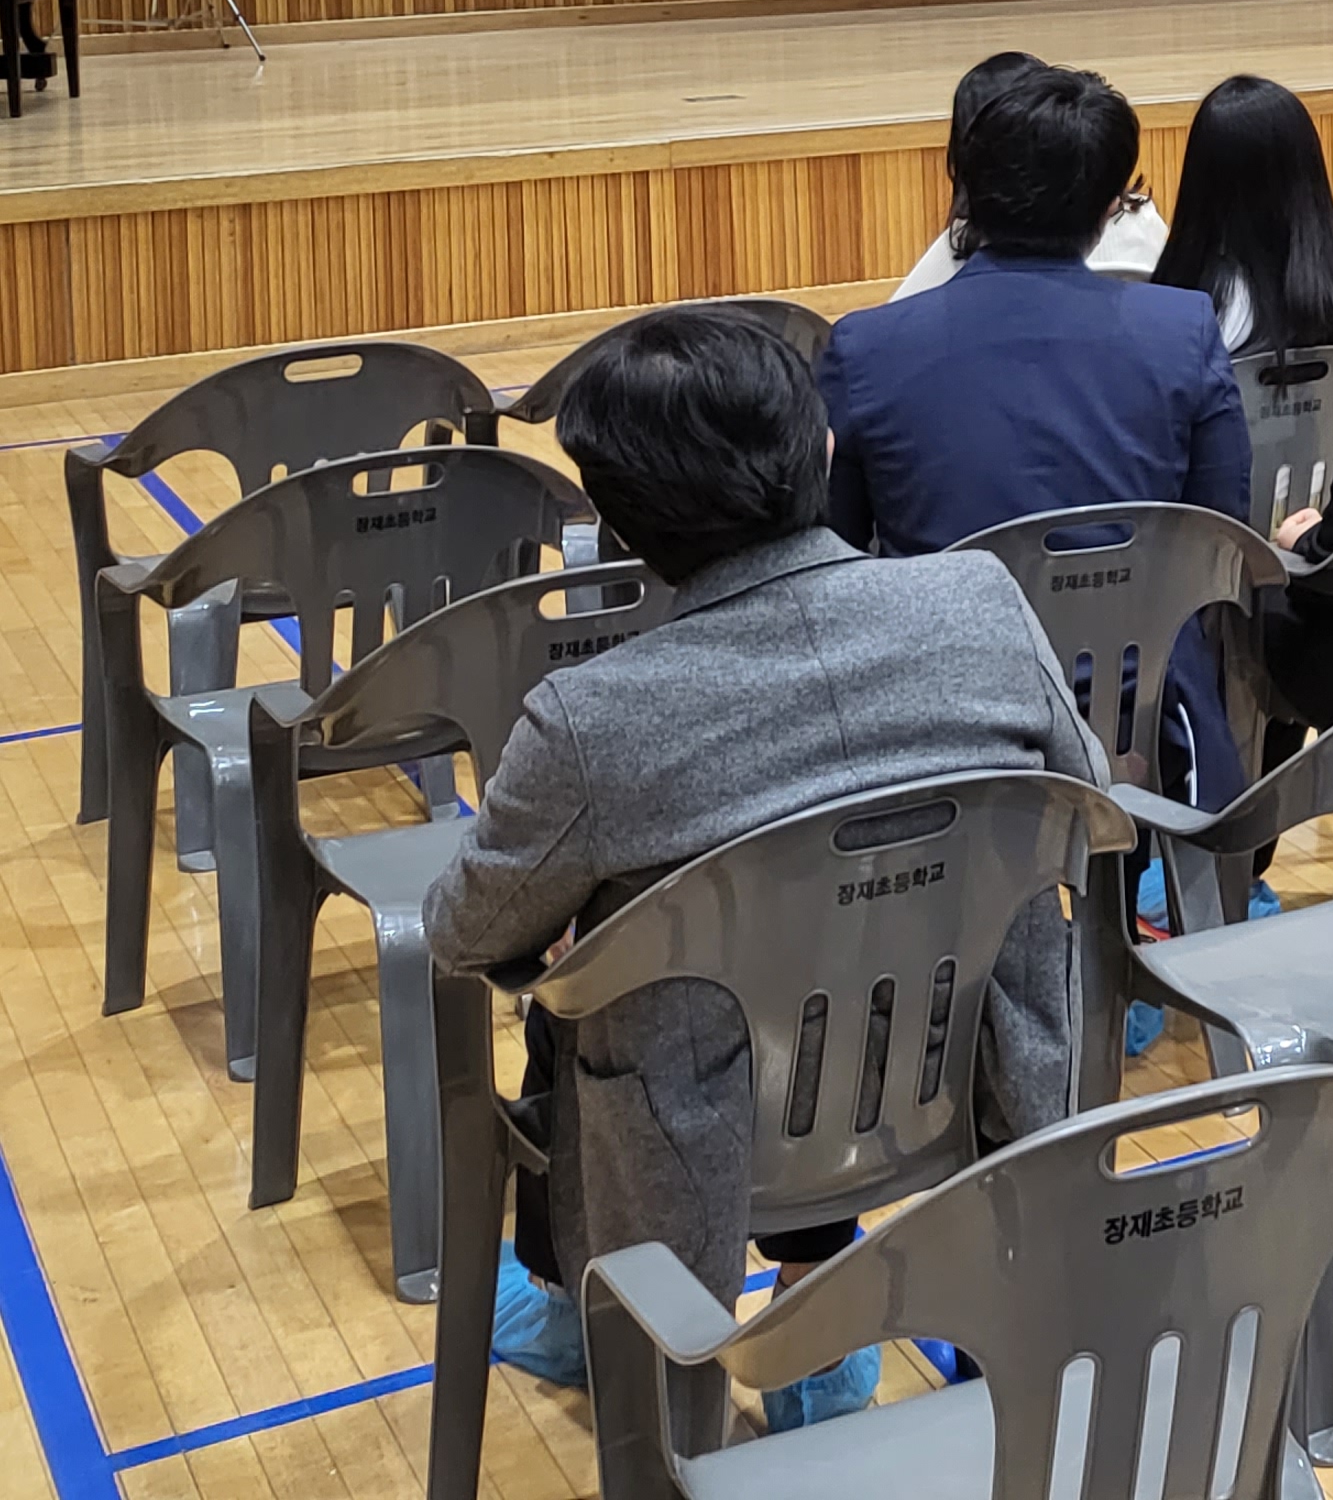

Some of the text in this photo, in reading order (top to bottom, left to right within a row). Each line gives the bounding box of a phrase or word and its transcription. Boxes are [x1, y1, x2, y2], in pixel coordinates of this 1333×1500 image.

[356, 507, 437, 533] 장재초등학교
[1051, 568, 1132, 593] 장재초등학교
[548, 631, 641, 661] 장재초등학
[836, 861, 946, 907] 장재초등학교
[1103, 1185, 1246, 1246] 장재초등학교
